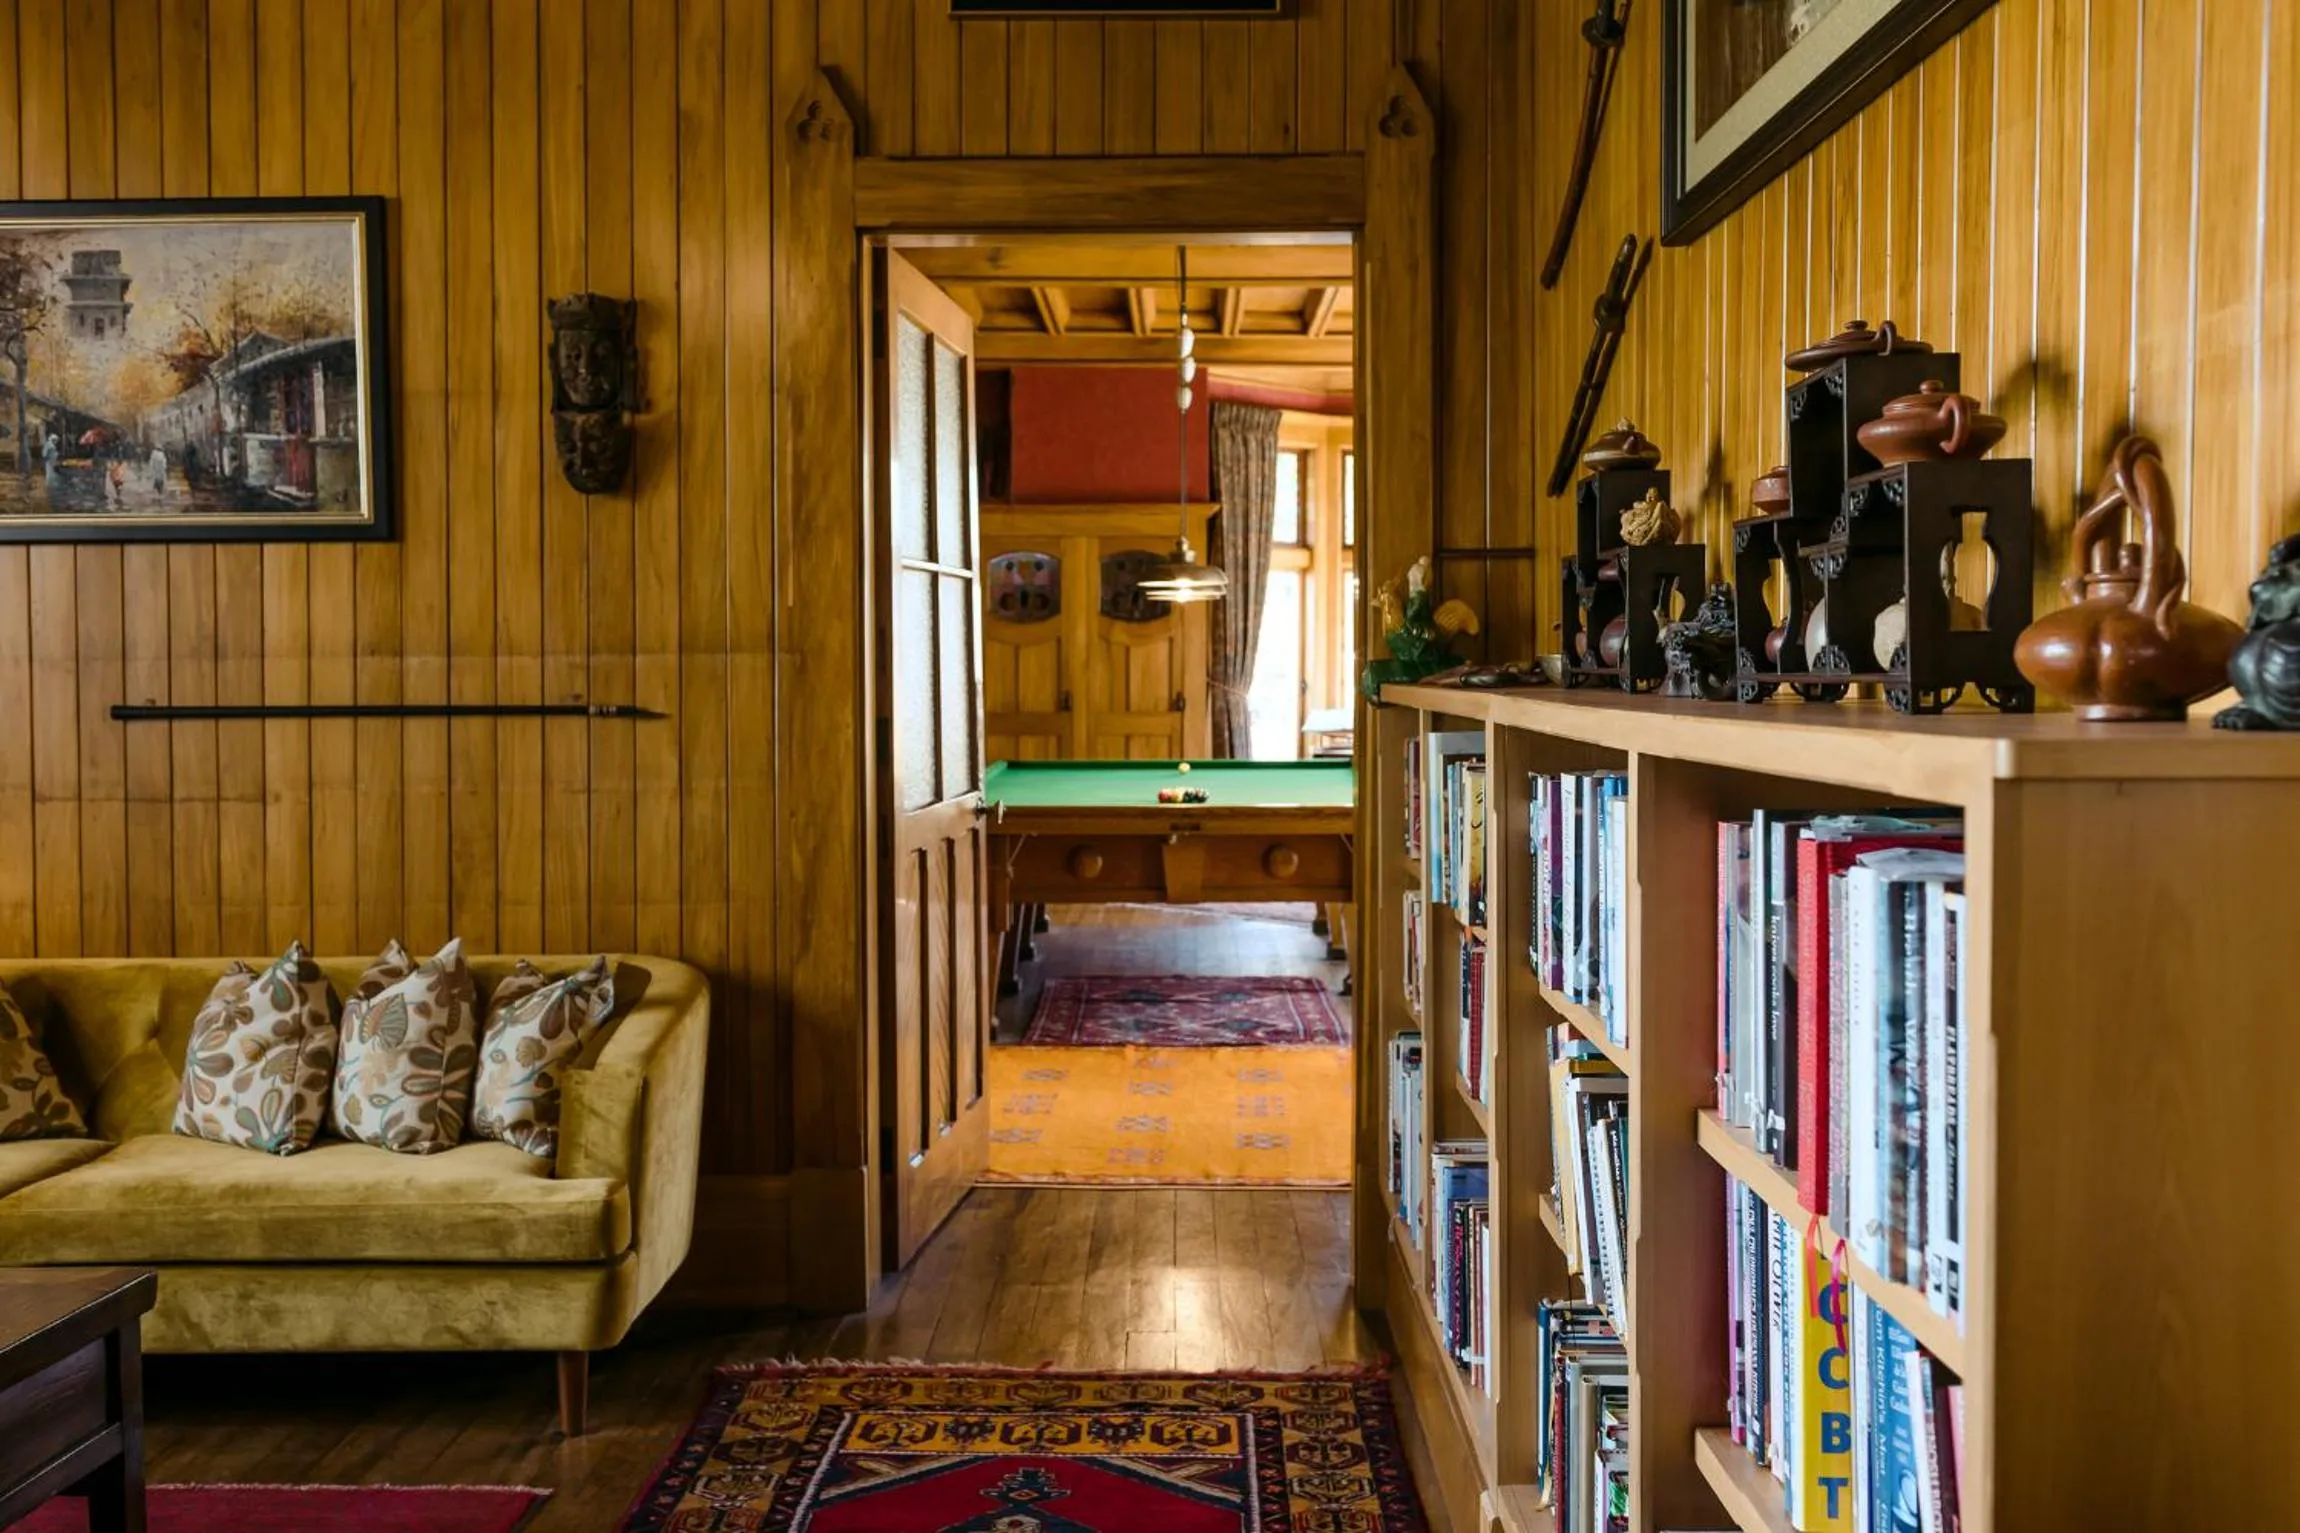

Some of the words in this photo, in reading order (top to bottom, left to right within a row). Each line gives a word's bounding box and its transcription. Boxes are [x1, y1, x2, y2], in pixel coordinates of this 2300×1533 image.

[1771, 916, 1781, 962] knives
[1771, 964, 1780, 1007] cooks
[1771, 1010, 1780, 1041] love
